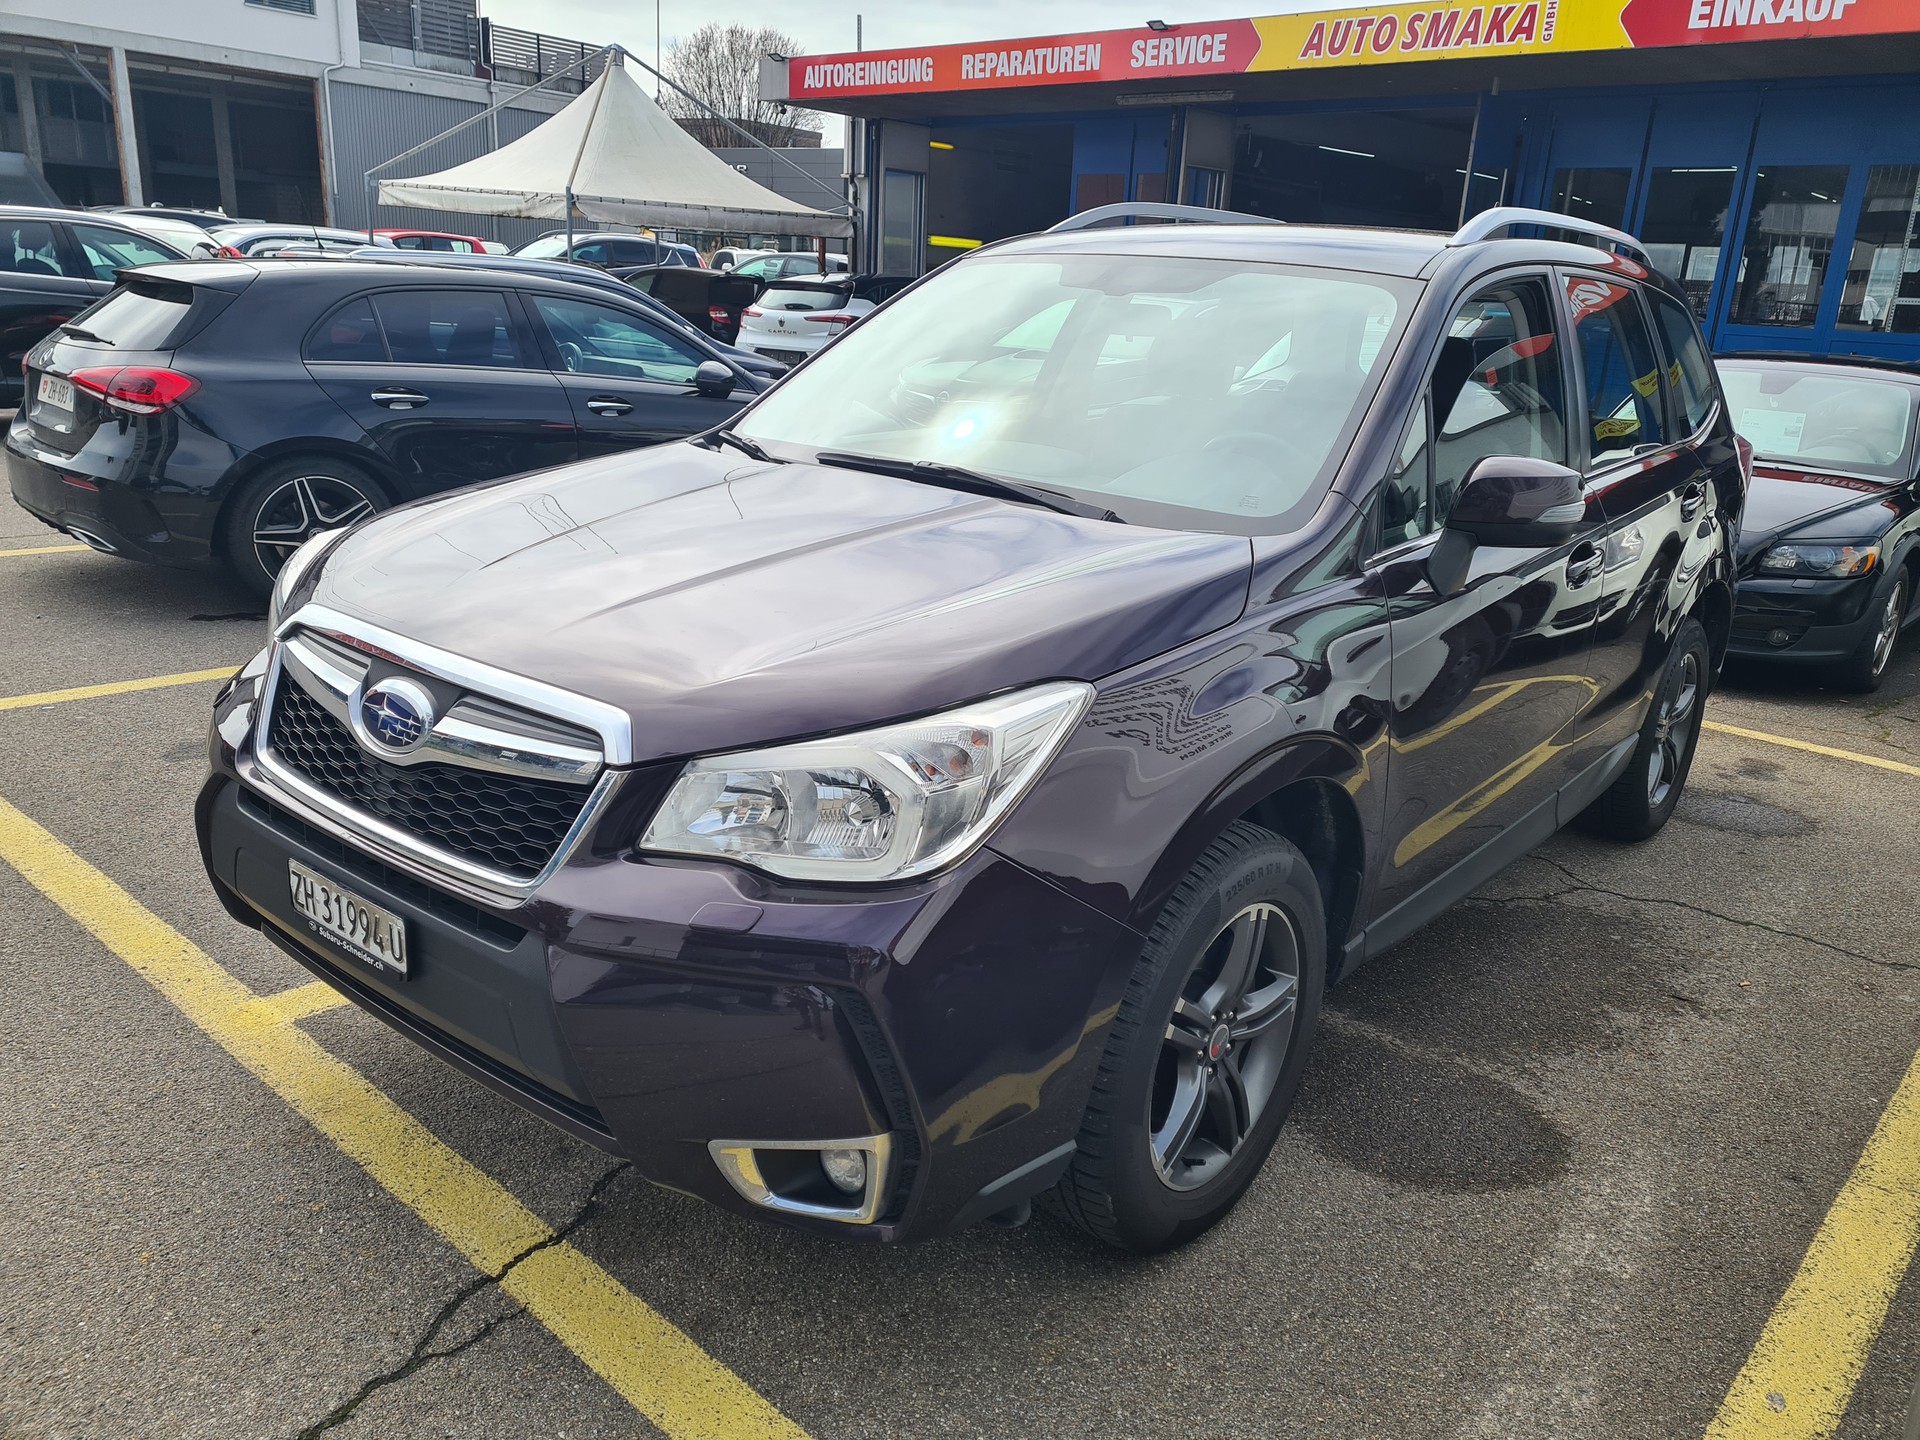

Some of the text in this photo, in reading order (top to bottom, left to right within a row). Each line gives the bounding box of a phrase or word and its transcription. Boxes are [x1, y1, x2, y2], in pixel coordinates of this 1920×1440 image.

[1298, 2, 1540, 60] AUTO SMAKA
[1542, 1, 1558, 42] GMBH
[803, 33, 1228, 89] AUTOREINIGUNG REPARATUREN SERVICE
